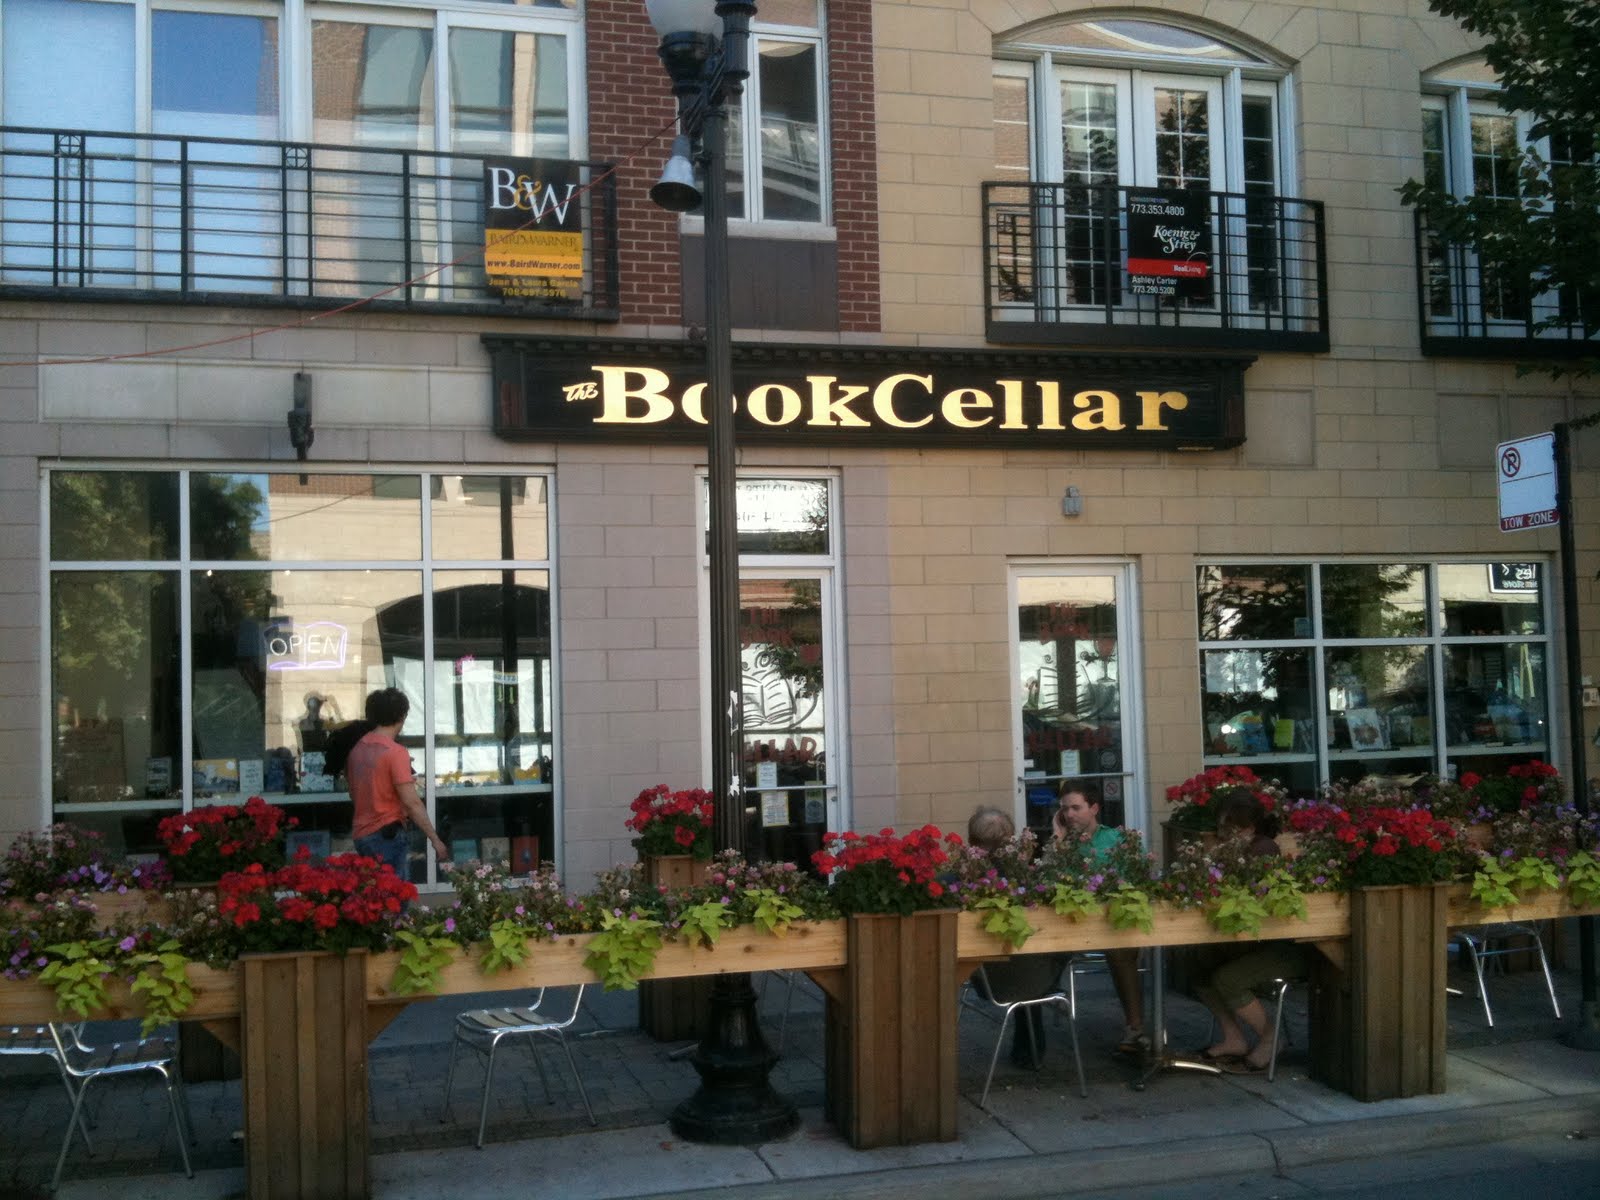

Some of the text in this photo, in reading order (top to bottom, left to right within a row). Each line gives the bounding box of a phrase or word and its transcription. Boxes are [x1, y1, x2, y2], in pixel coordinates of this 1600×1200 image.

[488, 166, 577, 226] B&W
[1163, 237, 1197, 253] Strey
[487, 259, 581, 271] www.BairdWarner.com
[1132, 276, 1155, 285] Ashley
[1503, 510, 1554, 530] TOW ZONE
[269, 631, 341, 657] OPEN
